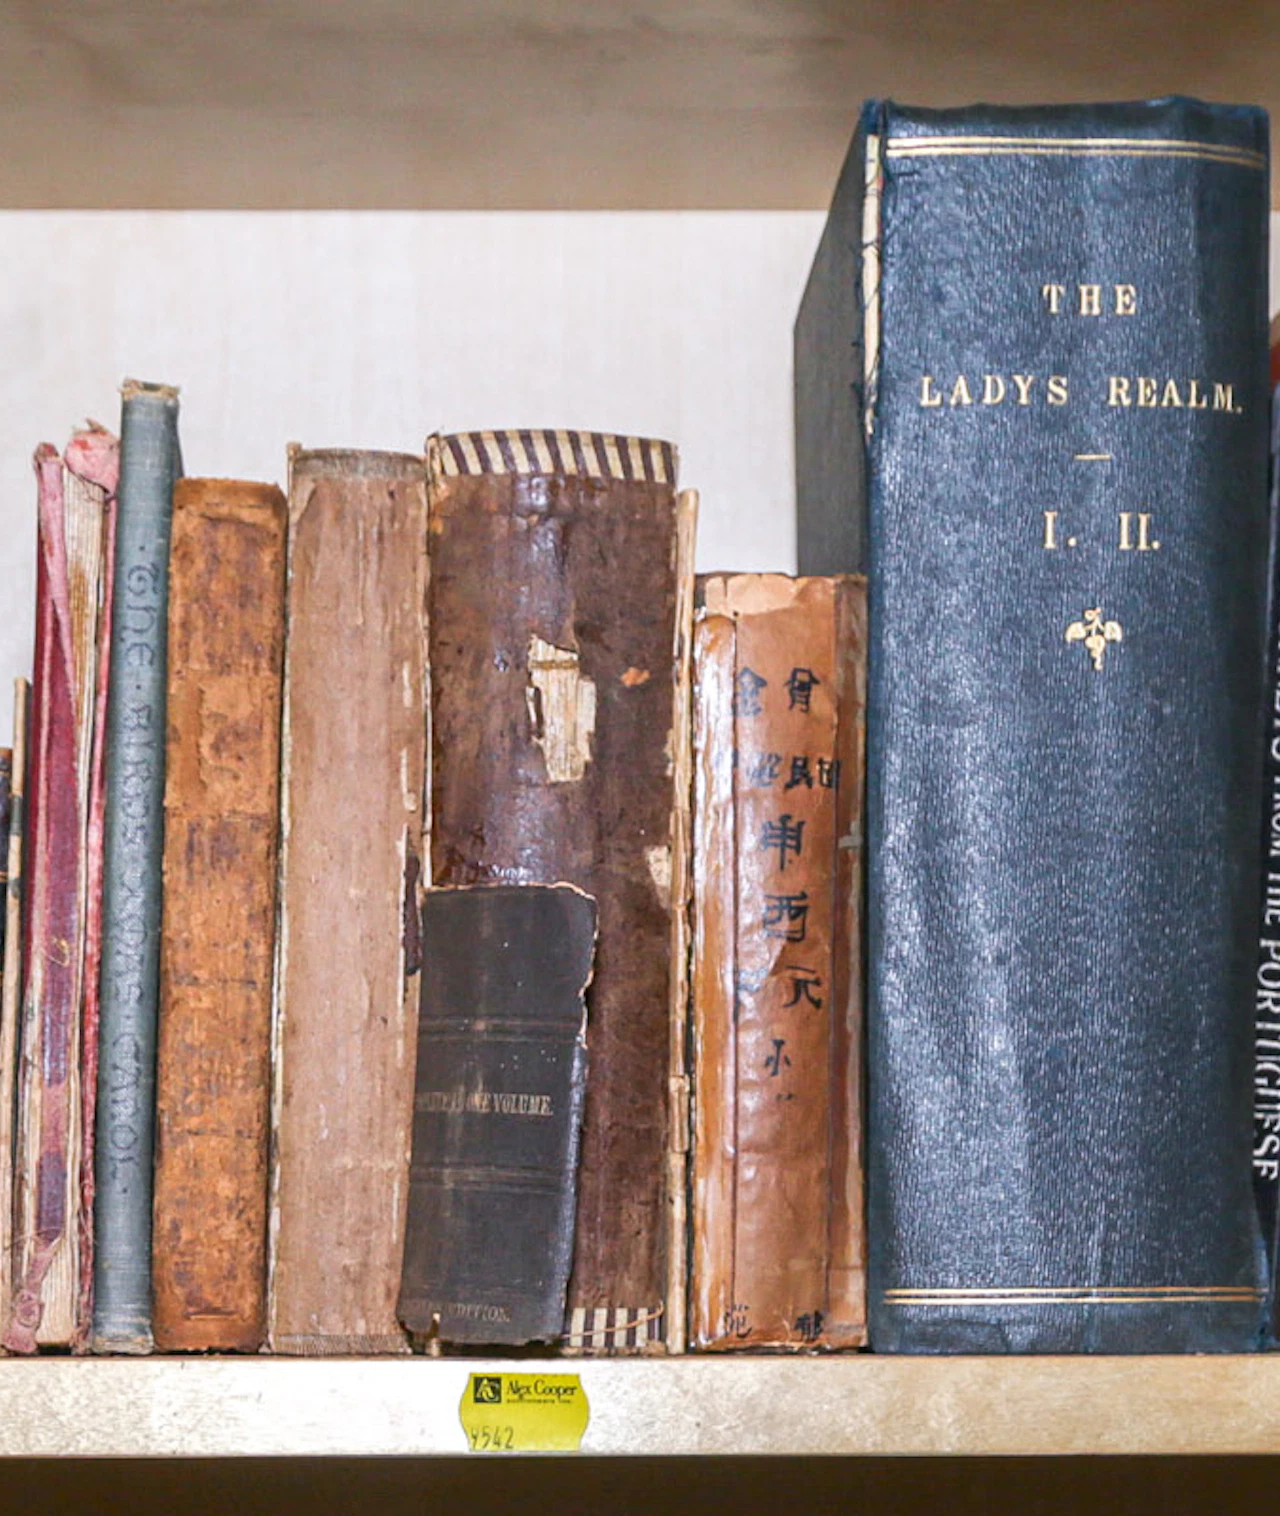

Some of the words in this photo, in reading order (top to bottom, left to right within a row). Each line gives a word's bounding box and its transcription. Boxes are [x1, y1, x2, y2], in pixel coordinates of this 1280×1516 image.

[1043, 284, 1136, 316] THE
[920, 374, 1069, 407] LADYS
[1107, 376, 1243, 414] REALM.
[1119, 512, 1161, 550] II.
[110, 1032, 141, 1181] CAROL
[493, 1093, 554, 1116] VOLUME.
[507, 1380, 532, 1400] Alex
[534, 1380, 577, 1400] Cooper
